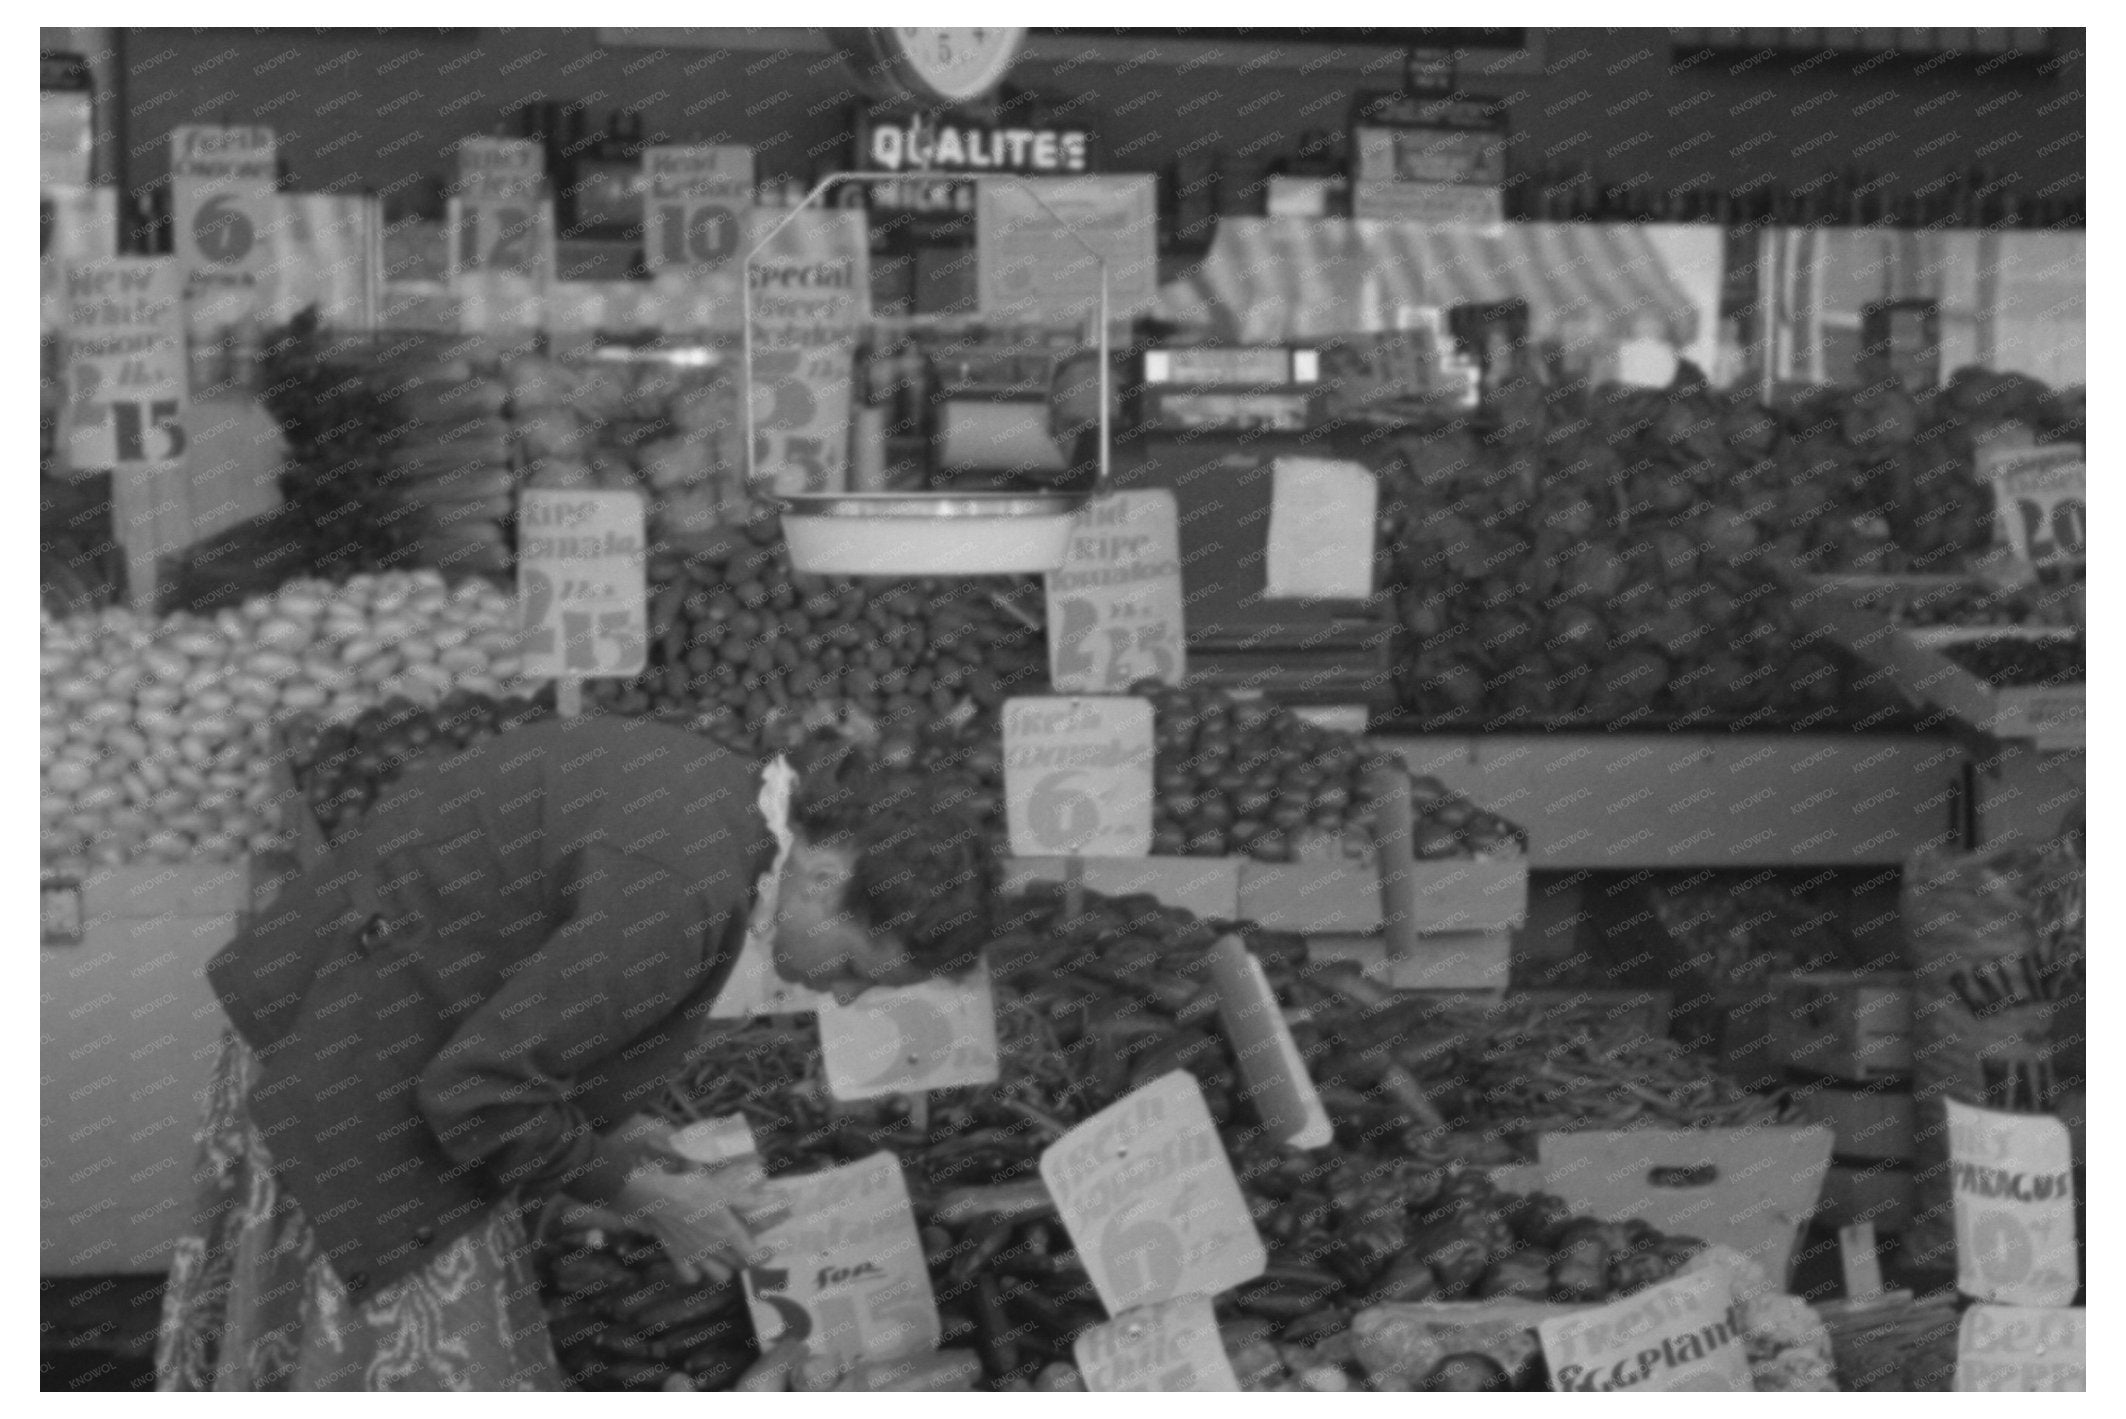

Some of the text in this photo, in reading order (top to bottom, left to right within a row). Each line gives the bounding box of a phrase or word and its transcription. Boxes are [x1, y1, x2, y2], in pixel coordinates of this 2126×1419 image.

[191, 193, 256, 268] 6
[461, 205, 532, 272] 12
[660, 203, 741, 270] 10
[111, 401, 188, 463] 15
[562, 609, 645, 671] 15
[1057, 599, 1099, 676] 2
[1027, 769, 1101, 850] 6
